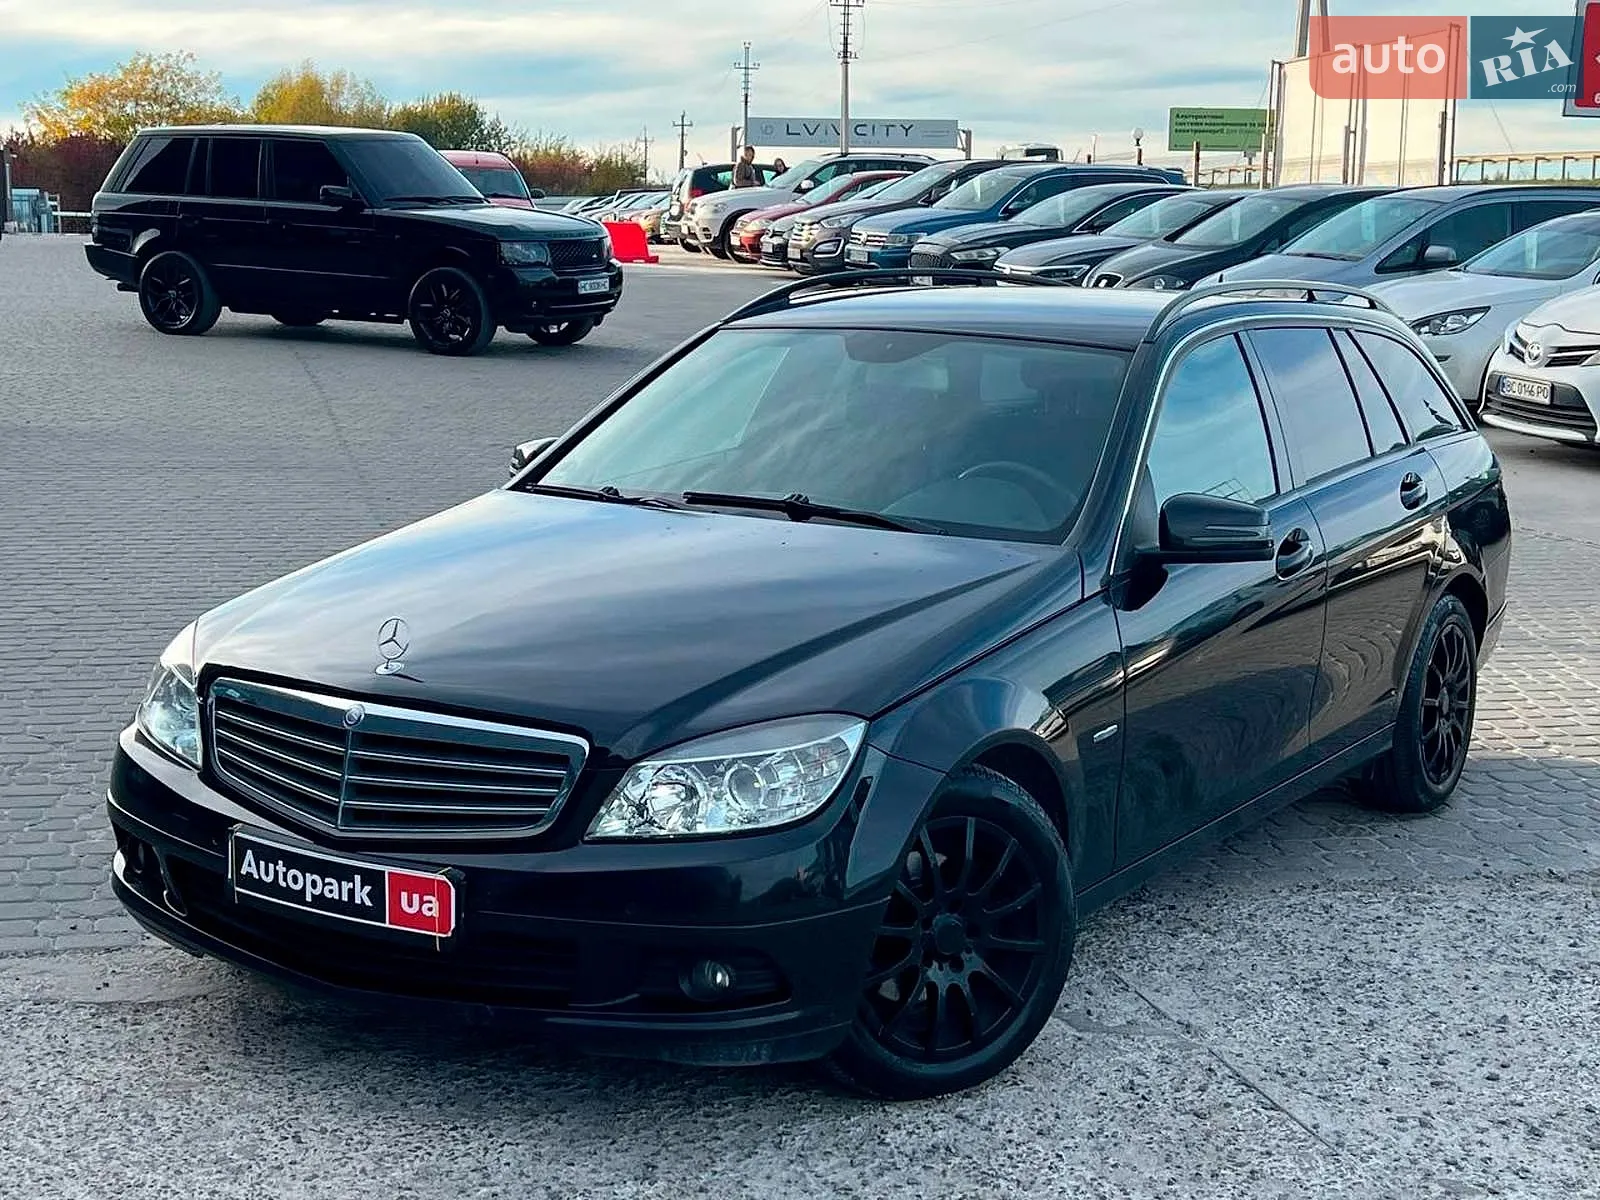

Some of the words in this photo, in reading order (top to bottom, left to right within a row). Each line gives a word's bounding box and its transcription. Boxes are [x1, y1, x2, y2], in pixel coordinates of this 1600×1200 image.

[853, 122, 914, 138] CITY
[240, 849, 374, 907] Autopark
[400, 891, 440, 918] ua
